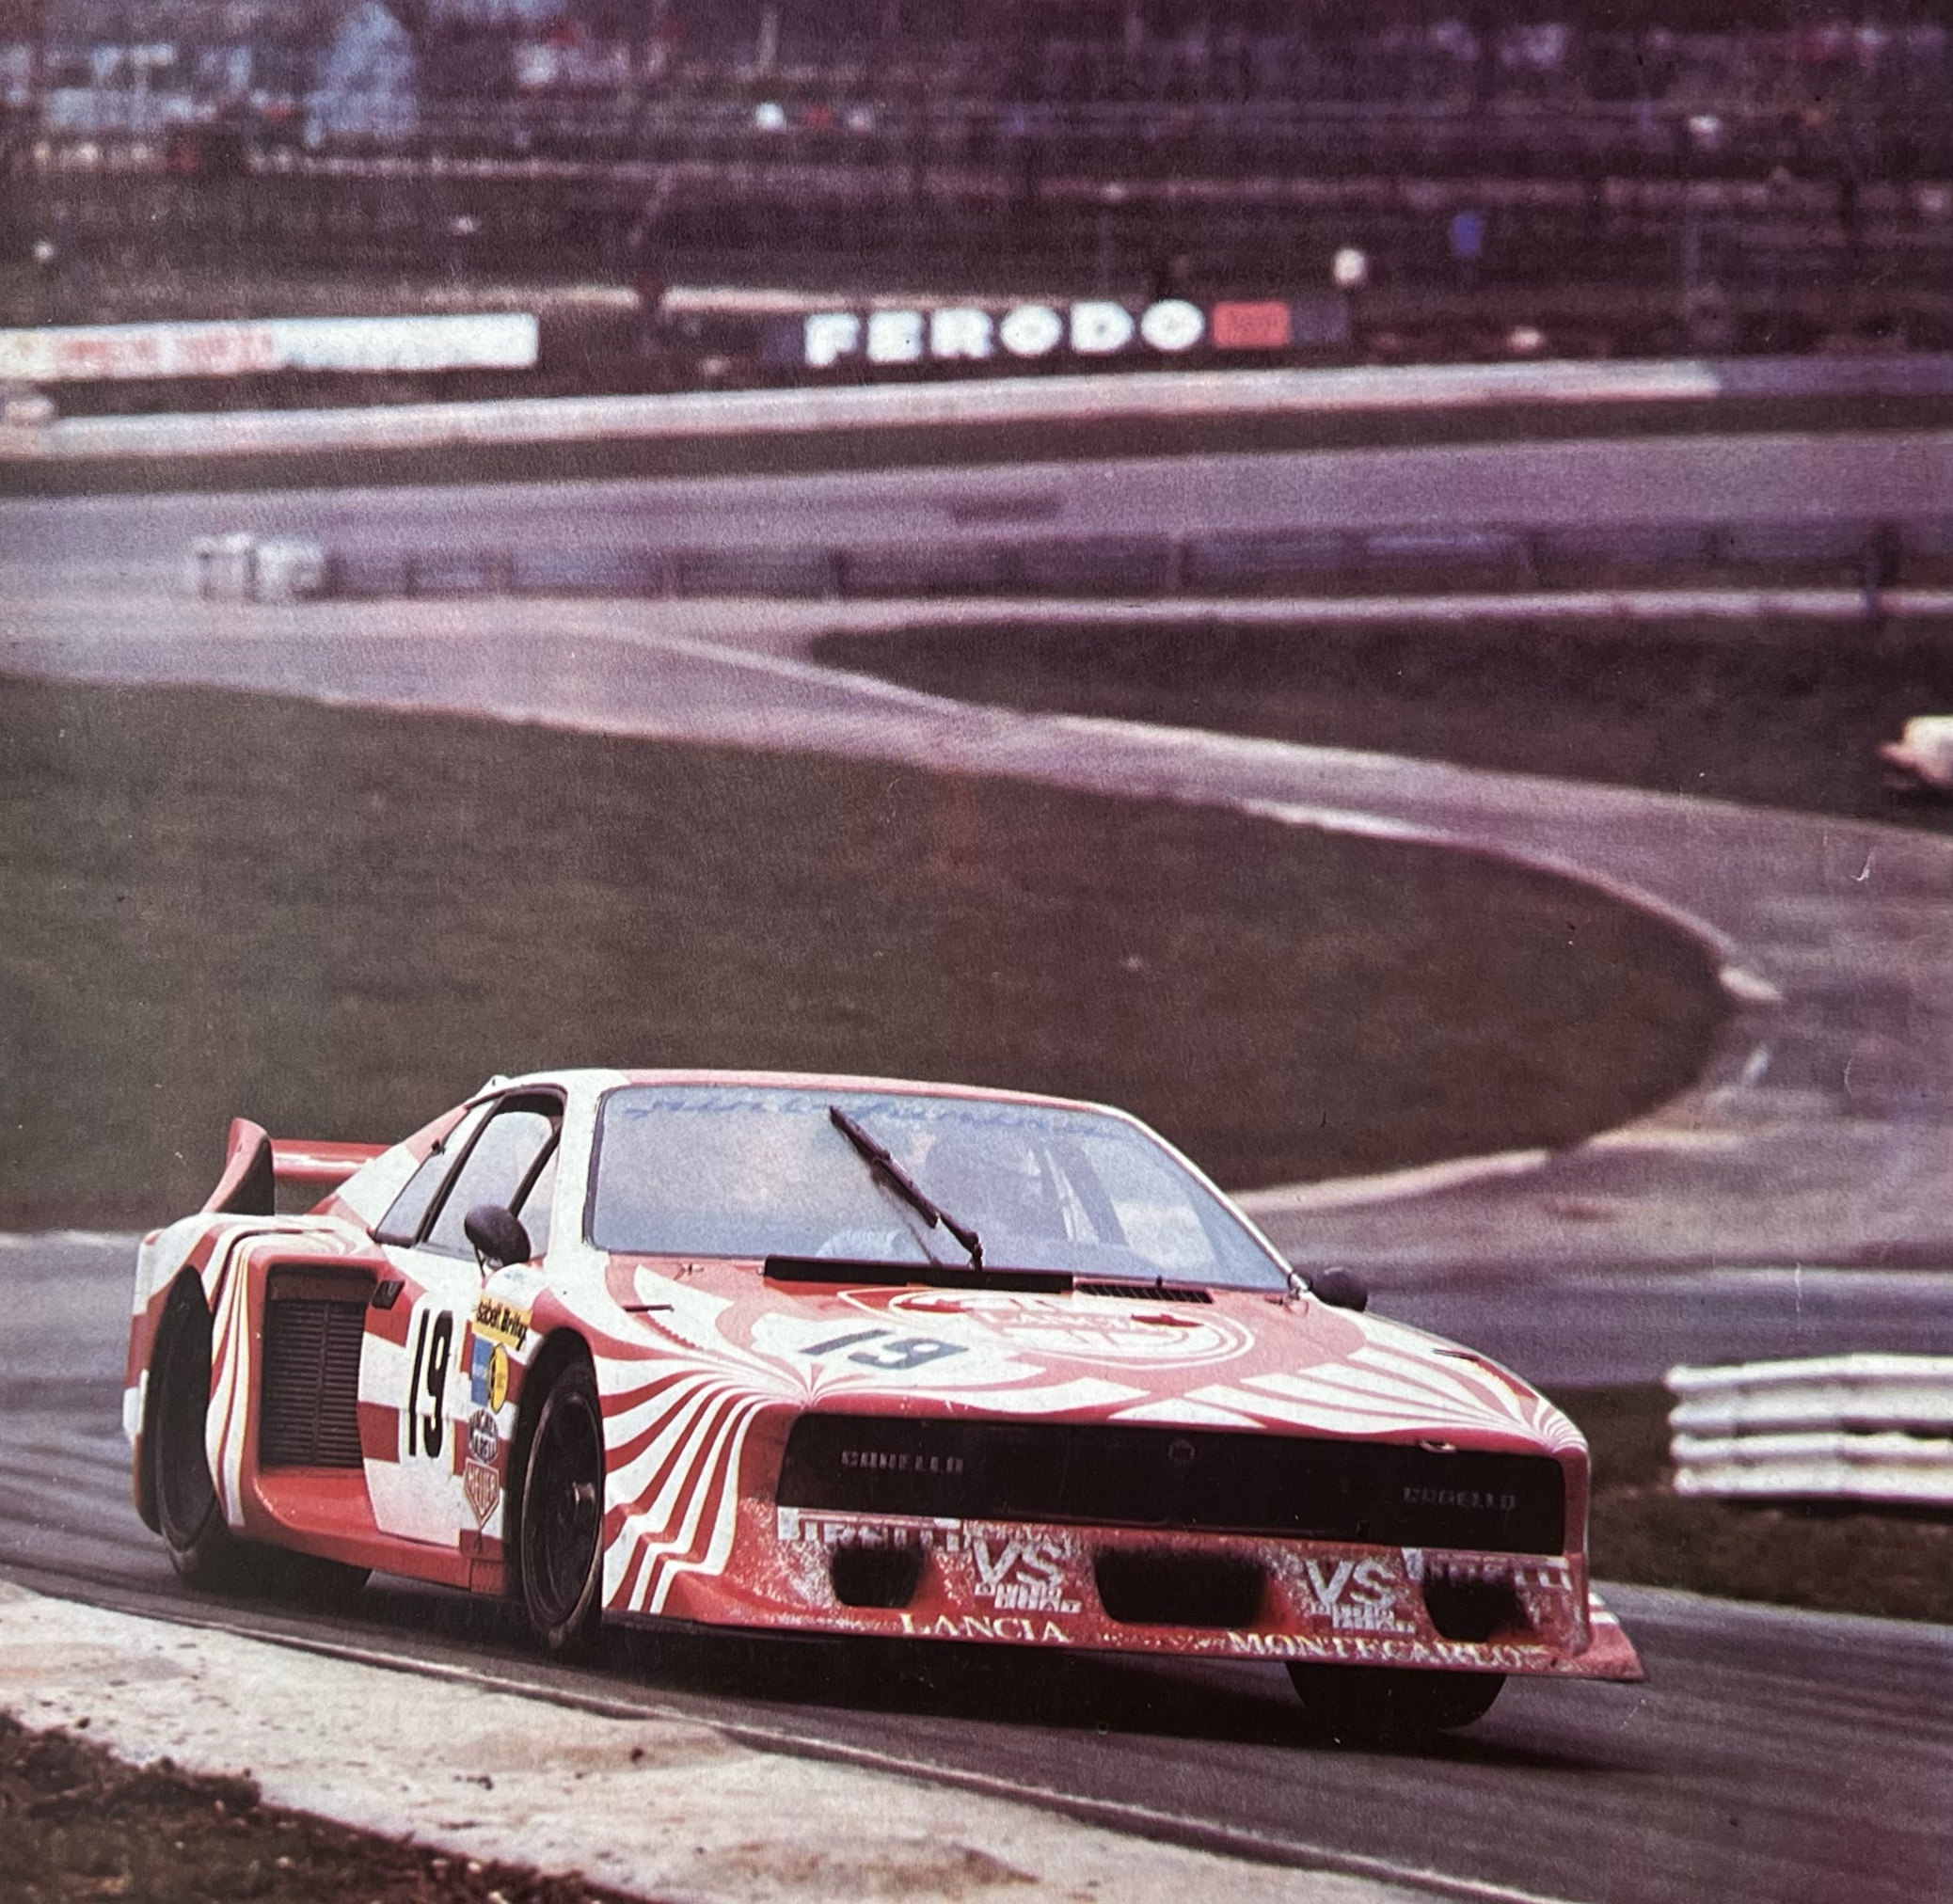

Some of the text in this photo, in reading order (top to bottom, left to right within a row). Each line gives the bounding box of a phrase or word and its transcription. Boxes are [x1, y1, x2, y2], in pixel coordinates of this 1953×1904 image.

[804, 299, 1203, 366] FERODO
[798, 1328, 970, 1370] 19
[408, 1308, 453, 1459] 19
[973, 1538, 1064, 1587] VS
[1305, 1557, 1398, 1609] VS
[899, 1612, 1074, 1644] LANCIA
